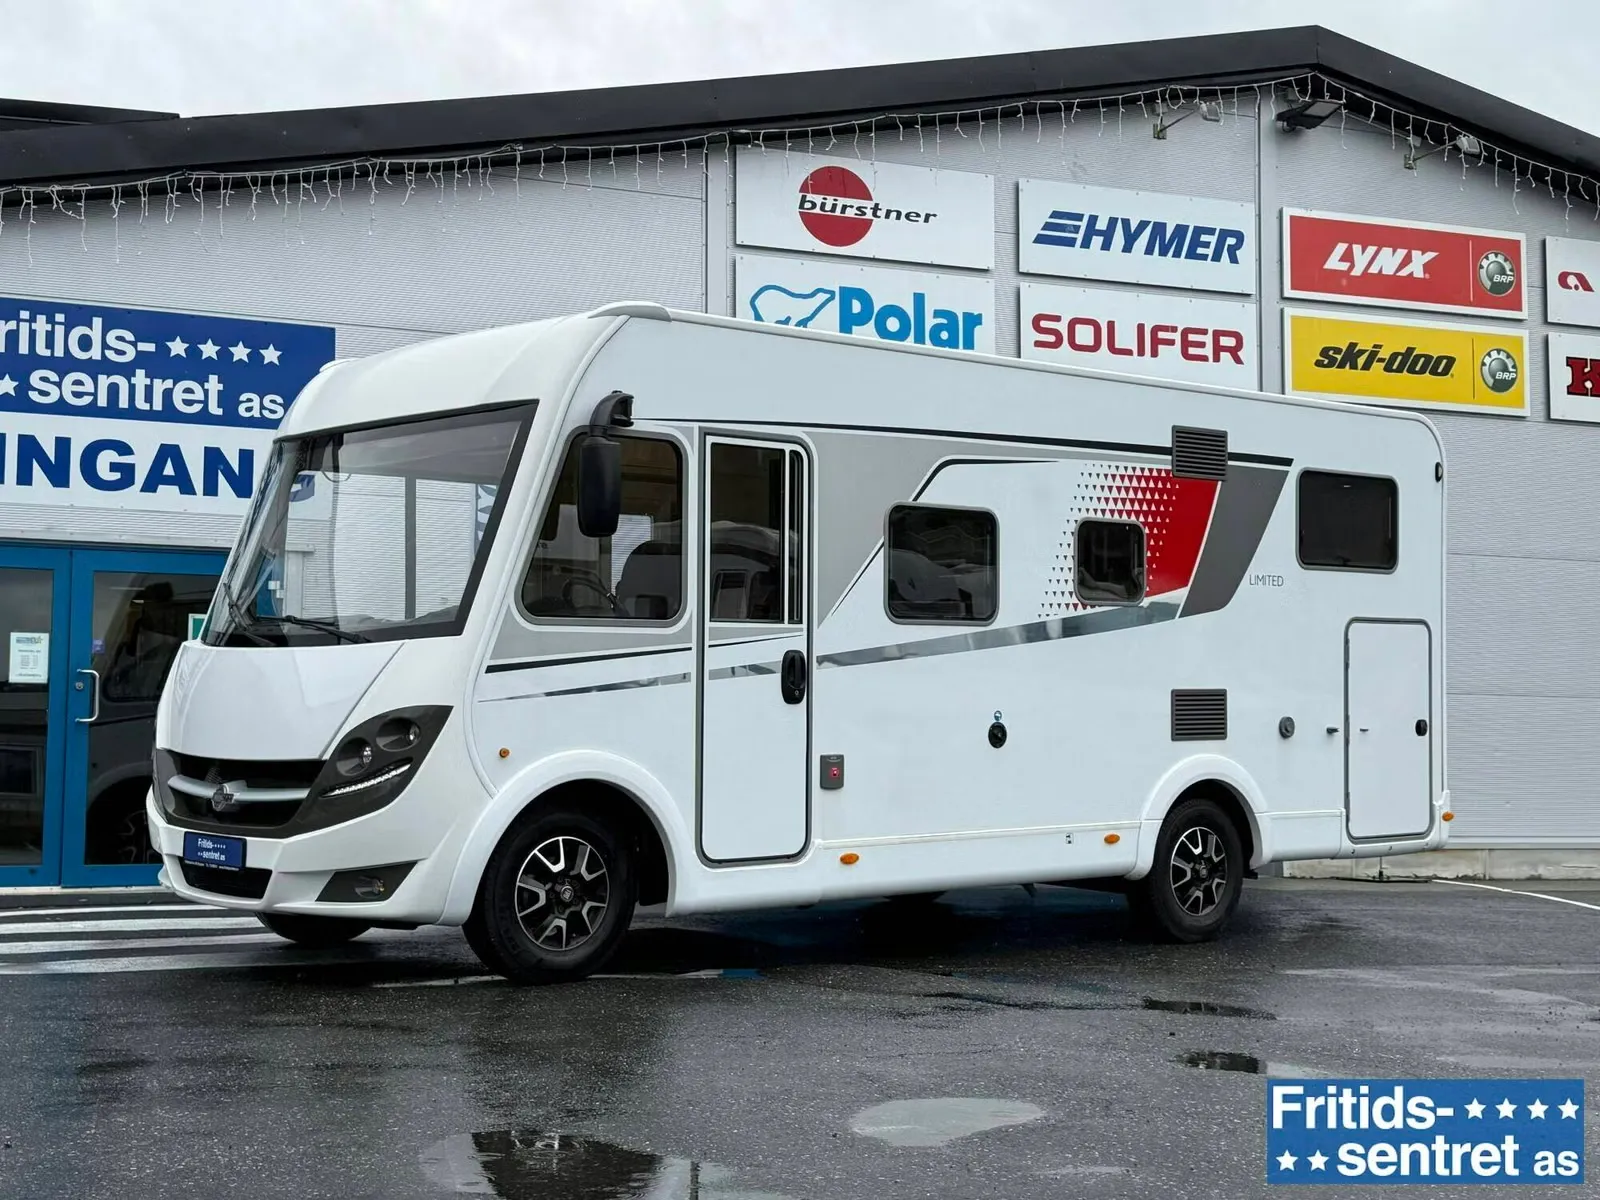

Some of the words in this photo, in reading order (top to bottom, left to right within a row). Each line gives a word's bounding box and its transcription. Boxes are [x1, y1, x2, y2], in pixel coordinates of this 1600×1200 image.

[798, 194, 937, 225] bürstner
[1077, 213, 1246, 265] HYMER
[1323, 242, 1439, 278] LYNX
[1494, 274, 1514, 284] BRP
[838, 286, 982, 349] Polar
[1031, 313, 1245, 365] SOLIFER
[1314, 341, 1457, 378] ski-doo
[1496, 371, 1516, 382] BRP
[28, 368, 224, 416] sentret
[237, 391, 285, 419] as
[1249, 574, 1284, 587] LIMITED
